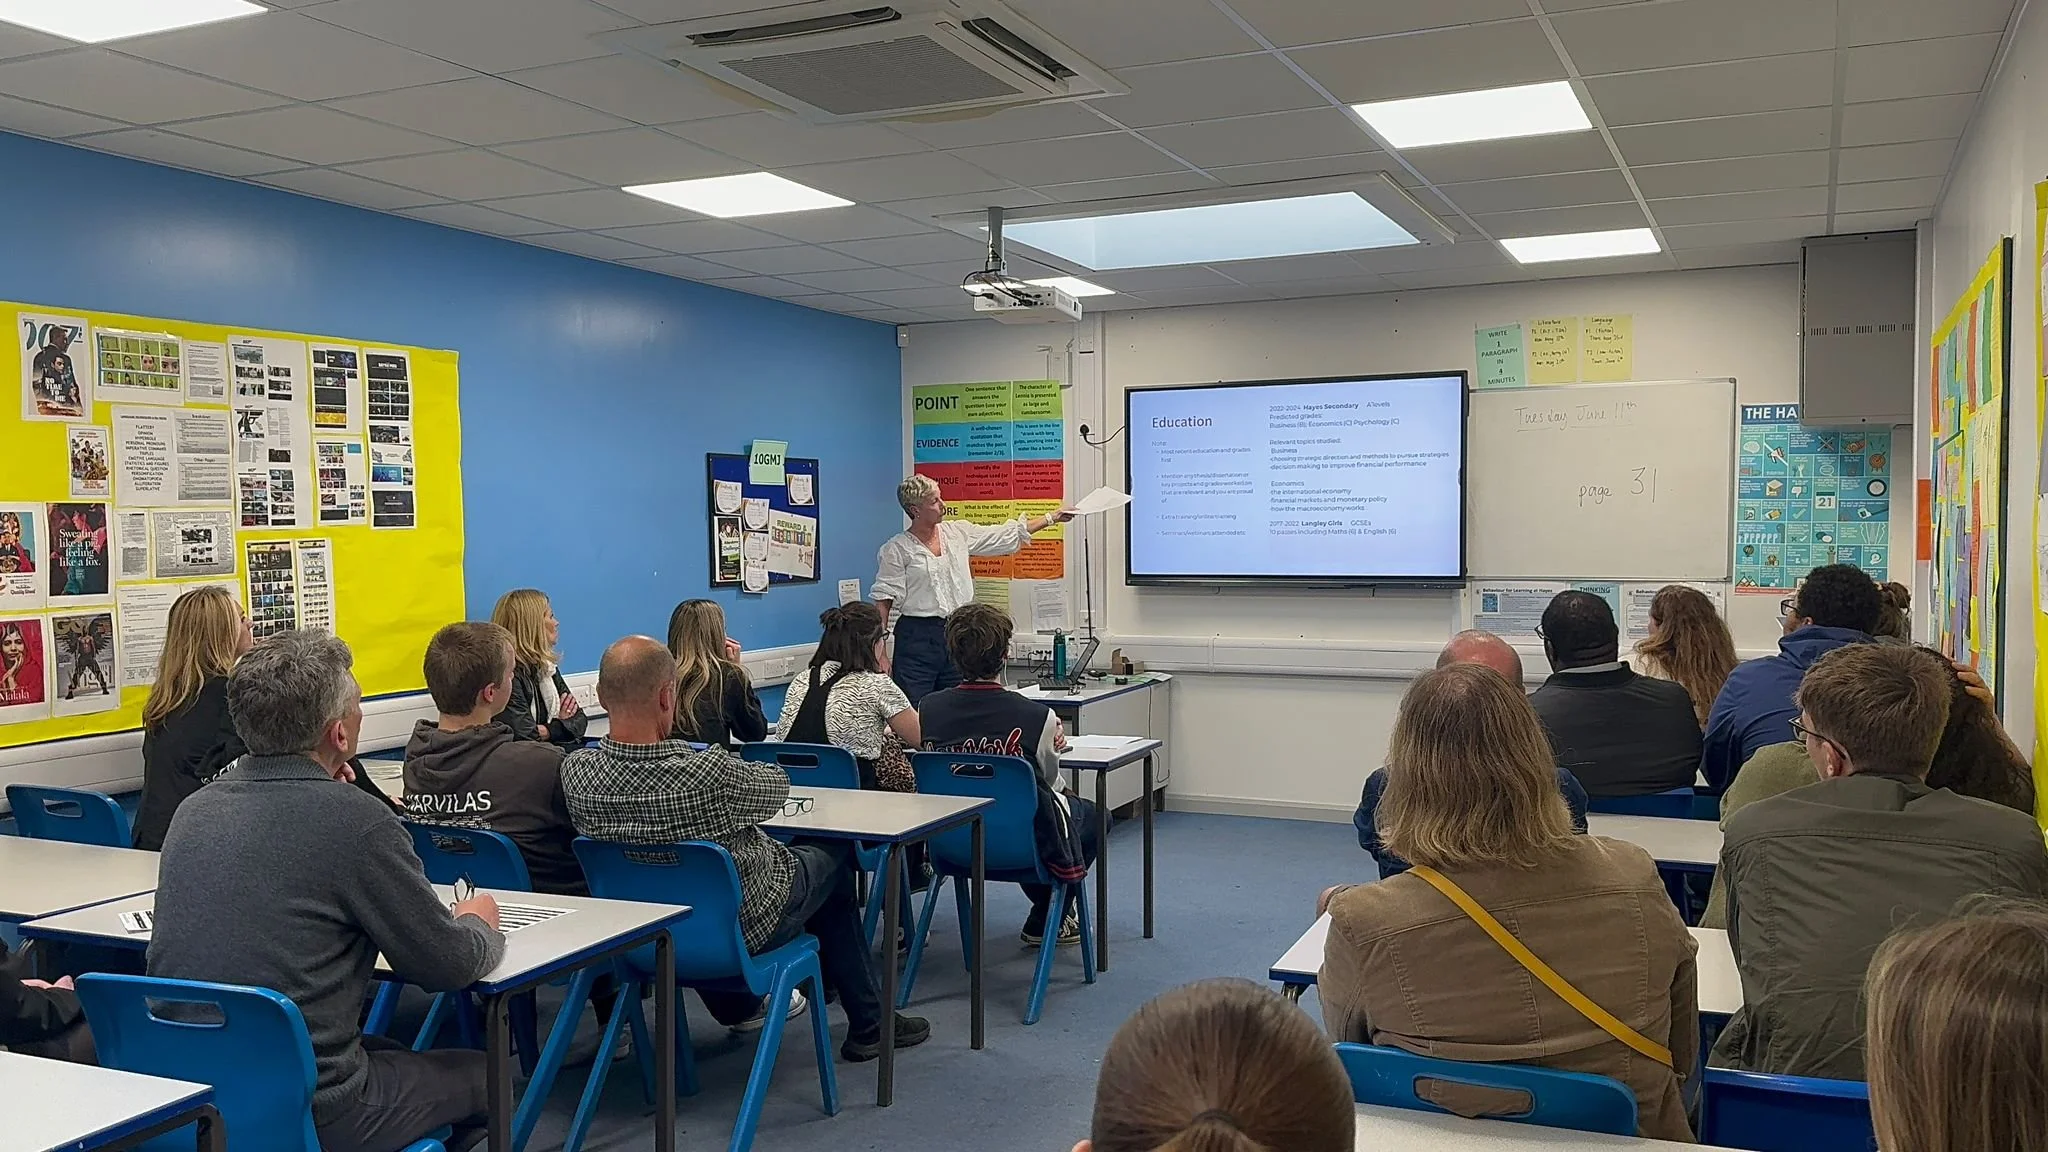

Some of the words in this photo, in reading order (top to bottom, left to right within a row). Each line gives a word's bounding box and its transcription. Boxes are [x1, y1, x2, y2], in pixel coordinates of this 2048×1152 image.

[1488, 329, 1508, 338] WRITE
[1481, 348, 1518, 357] PARAGRAPH
[1487, 376, 1516, 385] MINUTES
[915, 396, 959, 410] POINT
[1324, 402, 1359, 410] Secondary
[1514, 406, 1569, 430] Tuesday
[1576, 403, 1606, 422] June
[1614, 401, 1637, 420] 11th
[1745, 407, 1771, 419] THE
[1152, 415, 1212, 429] Education
[1308, 420, 1343, 428] Economics
[1353, 419, 1390, 427] Psychology
[916, 438, 959, 448] EVIDENCE
[1297, 438, 1315, 446] topics
[753, 453, 781, 466] 10GMJ
[1384, 460, 1427, 468] performance
[1578, 484, 1613, 507] page
[1630, 466, 1657, 504] 31
[1368, 495, 1388, 503] policy
[1817, 497, 1832, 507] 21
[776, 519, 802, 531] REWARD
[1301, 520, 1327, 528] Langley
[59, 528, 99, 541] Sweating
[1298, 528, 1327, 536] including
[1363, 528, 1388, 536] English
[59, 538, 76, 548] like
[66, 548, 95, 560] feeling
[59, 556, 76, 567] like
[85, 556, 101, 566] fox.
[1579, 586, 1611, 594] THINKING
